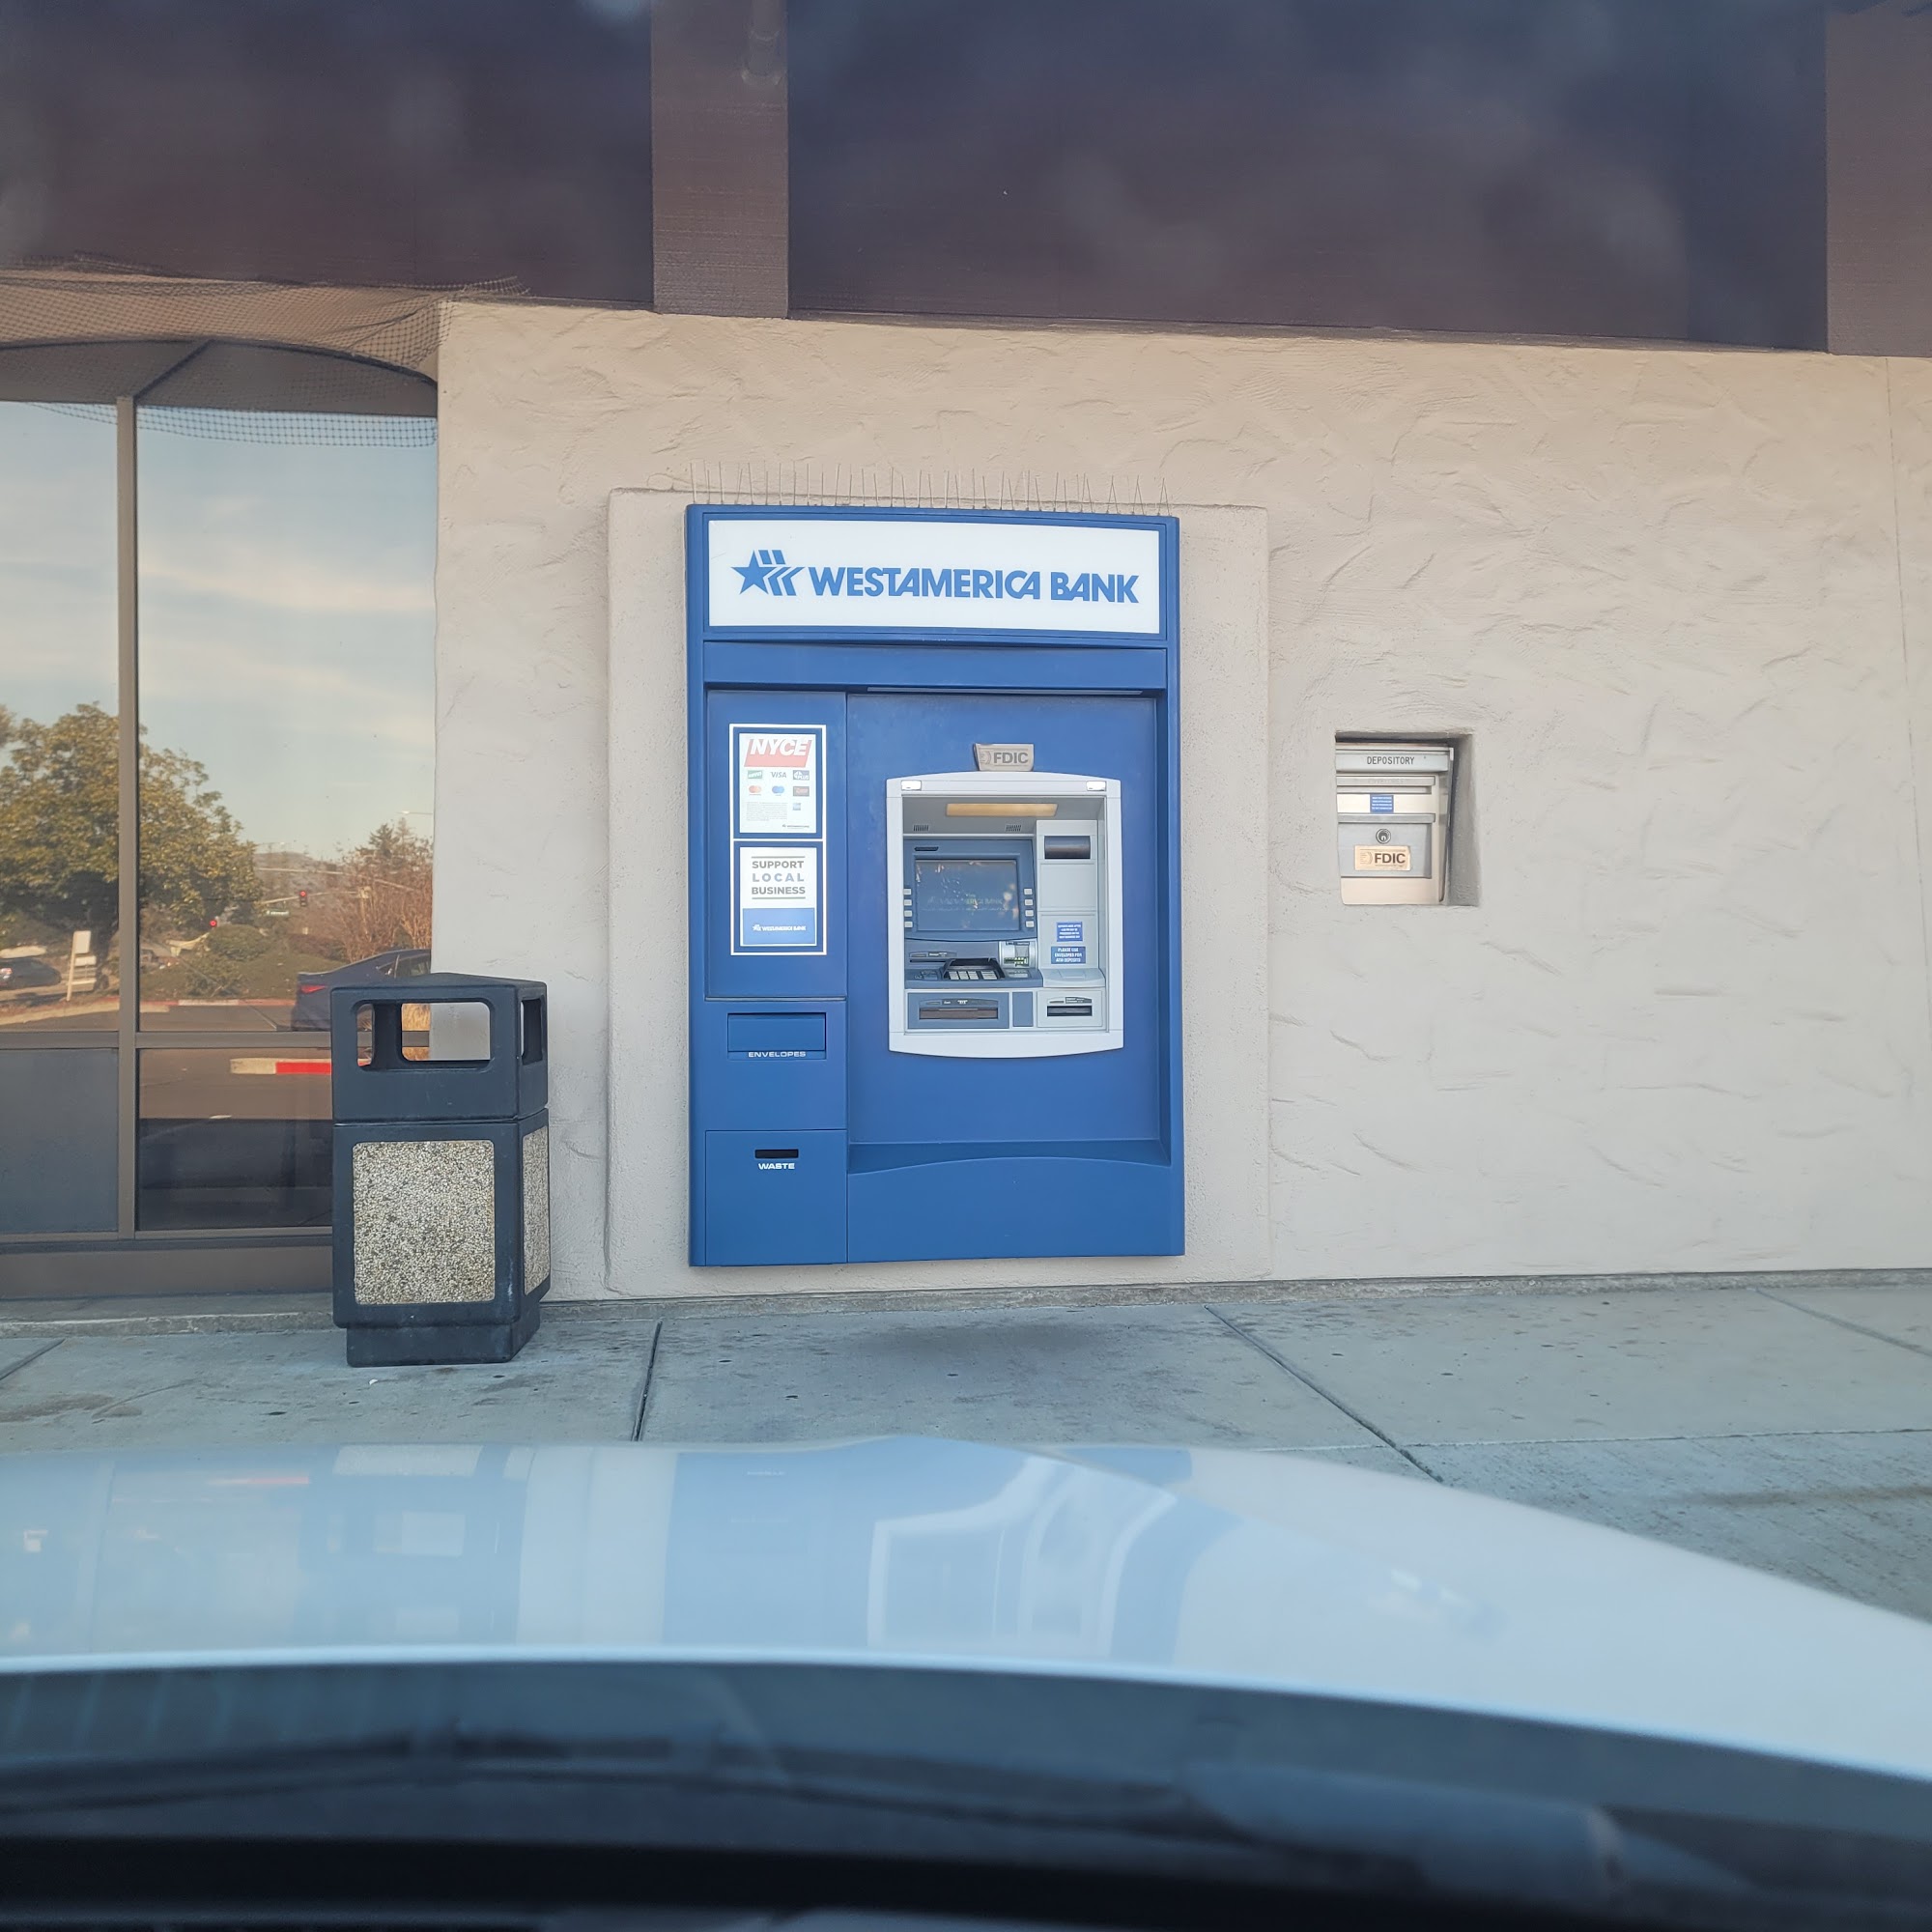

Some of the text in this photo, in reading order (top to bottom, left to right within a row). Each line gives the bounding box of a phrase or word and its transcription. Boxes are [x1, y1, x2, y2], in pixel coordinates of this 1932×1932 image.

[808, 566, 1139, 603] WESTAMERICA BANK
[750, 738, 809, 756] NYCE
[993, 752, 1029, 764] FDIC
[1366, 755, 1415, 765] DEPOSITORY
[1374, 852, 1406, 865] FDIC
[752, 861, 805, 869] SUPPORT
[752, 872, 805, 883] LOCAL
[752, 886, 806, 895] BUSINESS
